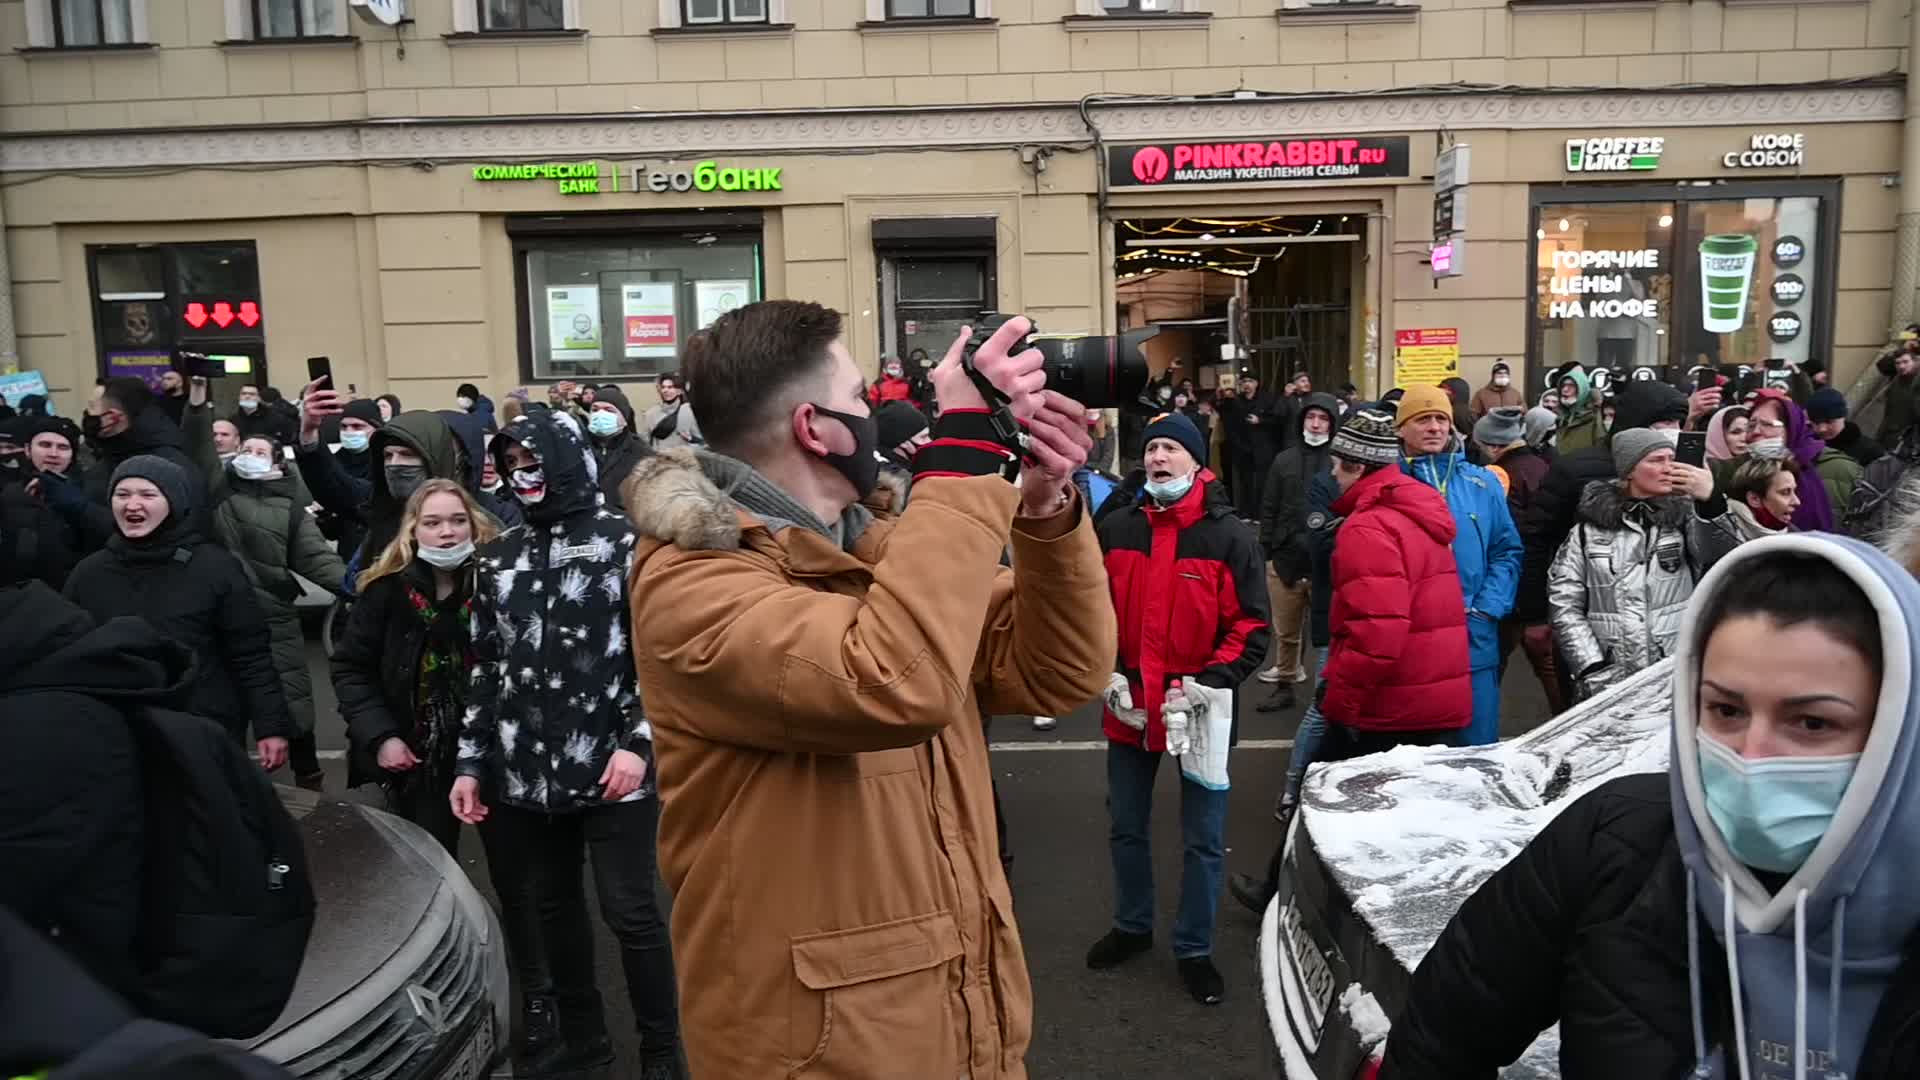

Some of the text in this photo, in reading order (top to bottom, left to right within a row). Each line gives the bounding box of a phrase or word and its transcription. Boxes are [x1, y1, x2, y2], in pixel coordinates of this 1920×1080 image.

[1587, 137, 1665, 154] COFFEE
[1751, 133, 1804, 150] КОФЕ
[1173, 139, 1386, 169] PINKRABBIT.RU
[1584, 154, 1632, 171] LIKE
[1723, 149, 1804, 168] С СОБОЙ
[473, 163, 598, 180] КОММЕРЧЕСКИЙ
[630, 161, 783, 193] Геобанк
[1174, 164, 1359, 181] МАГАЗИН УКРЕПЛЕНИЯ СЕМЬИ
[559, 179, 599, 195] БАНК
[1552, 249, 1659, 268] ГОРЯЧИЕ
[1550, 274, 1622, 296] ЦЕНЫ
[1549, 298, 1658, 318] НА КОФЕ
